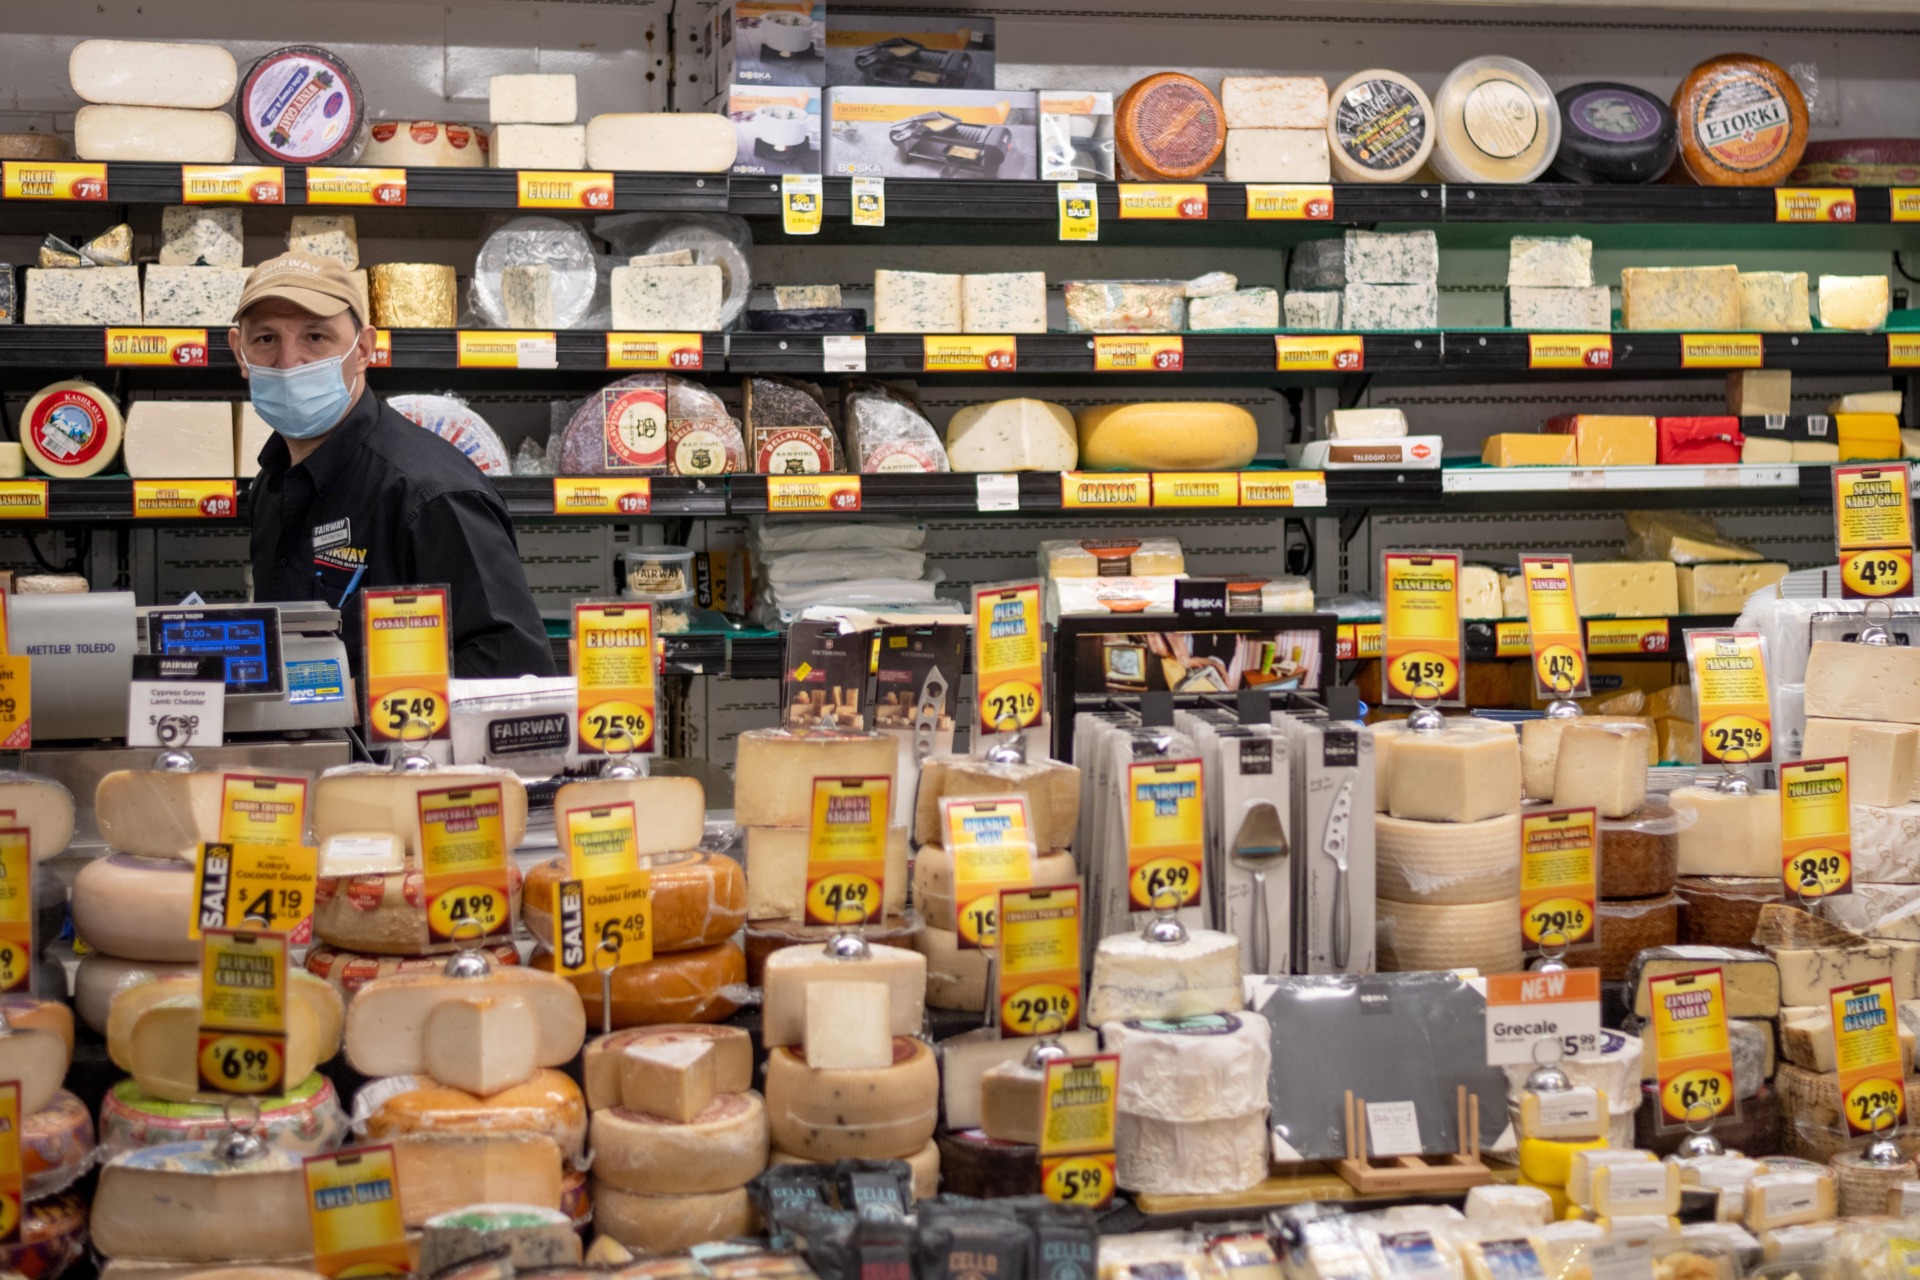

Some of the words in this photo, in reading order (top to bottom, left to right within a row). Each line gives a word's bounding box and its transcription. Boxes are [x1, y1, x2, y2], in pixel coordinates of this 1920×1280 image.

[739, 71, 771, 80] BOSKA
[1706, 103, 1780, 139] ETORKI
[733, 165, 765, 174] BOSKA
[837, 163, 882, 175] BOSKA
[791, 202, 815, 211] SALE
[859, 202, 879, 210] SALE
[1067, 208, 1091, 217] SALE
[113, 336, 128, 354] ST
[131, 336, 167, 354] AGUR
[63, 393, 104, 425] KASHKAVAL
[765, 430, 823, 452] BELLAVITANO
[1077, 483, 1137, 503] GRAYSON
[1853, 480, 1892, 495] SPANISH
[1845, 493, 1876, 508] NAKED
[1876, 492, 1902, 507] GOAT
[314, 519, 346, 536] FAIRWAY
[699, 560, 711, 606] SALE
[1393, 579, 1452, 592] MANCHEGO
[1182, 598, 1224, 609] BOSKA
[372, 616, 408, 630] OSSAU
[409, 615, 440, 629] IRATY
[184, 629, 205, 638] 0.00
[586, 628, 647, 648] ETORKI
[26, 644, 72, 655] METTLER
[76, 643, 116, 654] TOLEDO
[161, 661, 199, 670] FAIRWAY
[1705, 656, 1755, 670] MANCHEGO
[151, 689, 182, 698] Cypress
[182, 688, 206, 697] Grove
[291, 688, 315, 698] NYC
[493, 717, 566, 738] FAIRWAY
[1787, 778, 1842, 798] MOLITERNO
[257, 860, 291, 871] Koko's
[235, 870, 277, 881] Coconut
[280, 872, 313, 882] Gouda
[202, 857, 230, 927] SALE
[587, 893, 622, 906] Ossau
[624, 888, 649, 902] Iraty
[563, 896, 584, 965] SALE
[1520, 973, 1566, 1002] NEW
[1664, 989, 1712, 1010] ZIMBRO
[1845, 994, 1881, 1016] PETIT
[1493, 1020, 1558, 1037] Grecale
[1842, 1009, 1887, 1033] BASQUE
[772, 1187, 817, 1199] CELLO
[855, 1187, 897, 1201] CELLO
[1044, 1242, 1091, 1260] CELLO
[949, 1252, 998, 1270] CELLO
